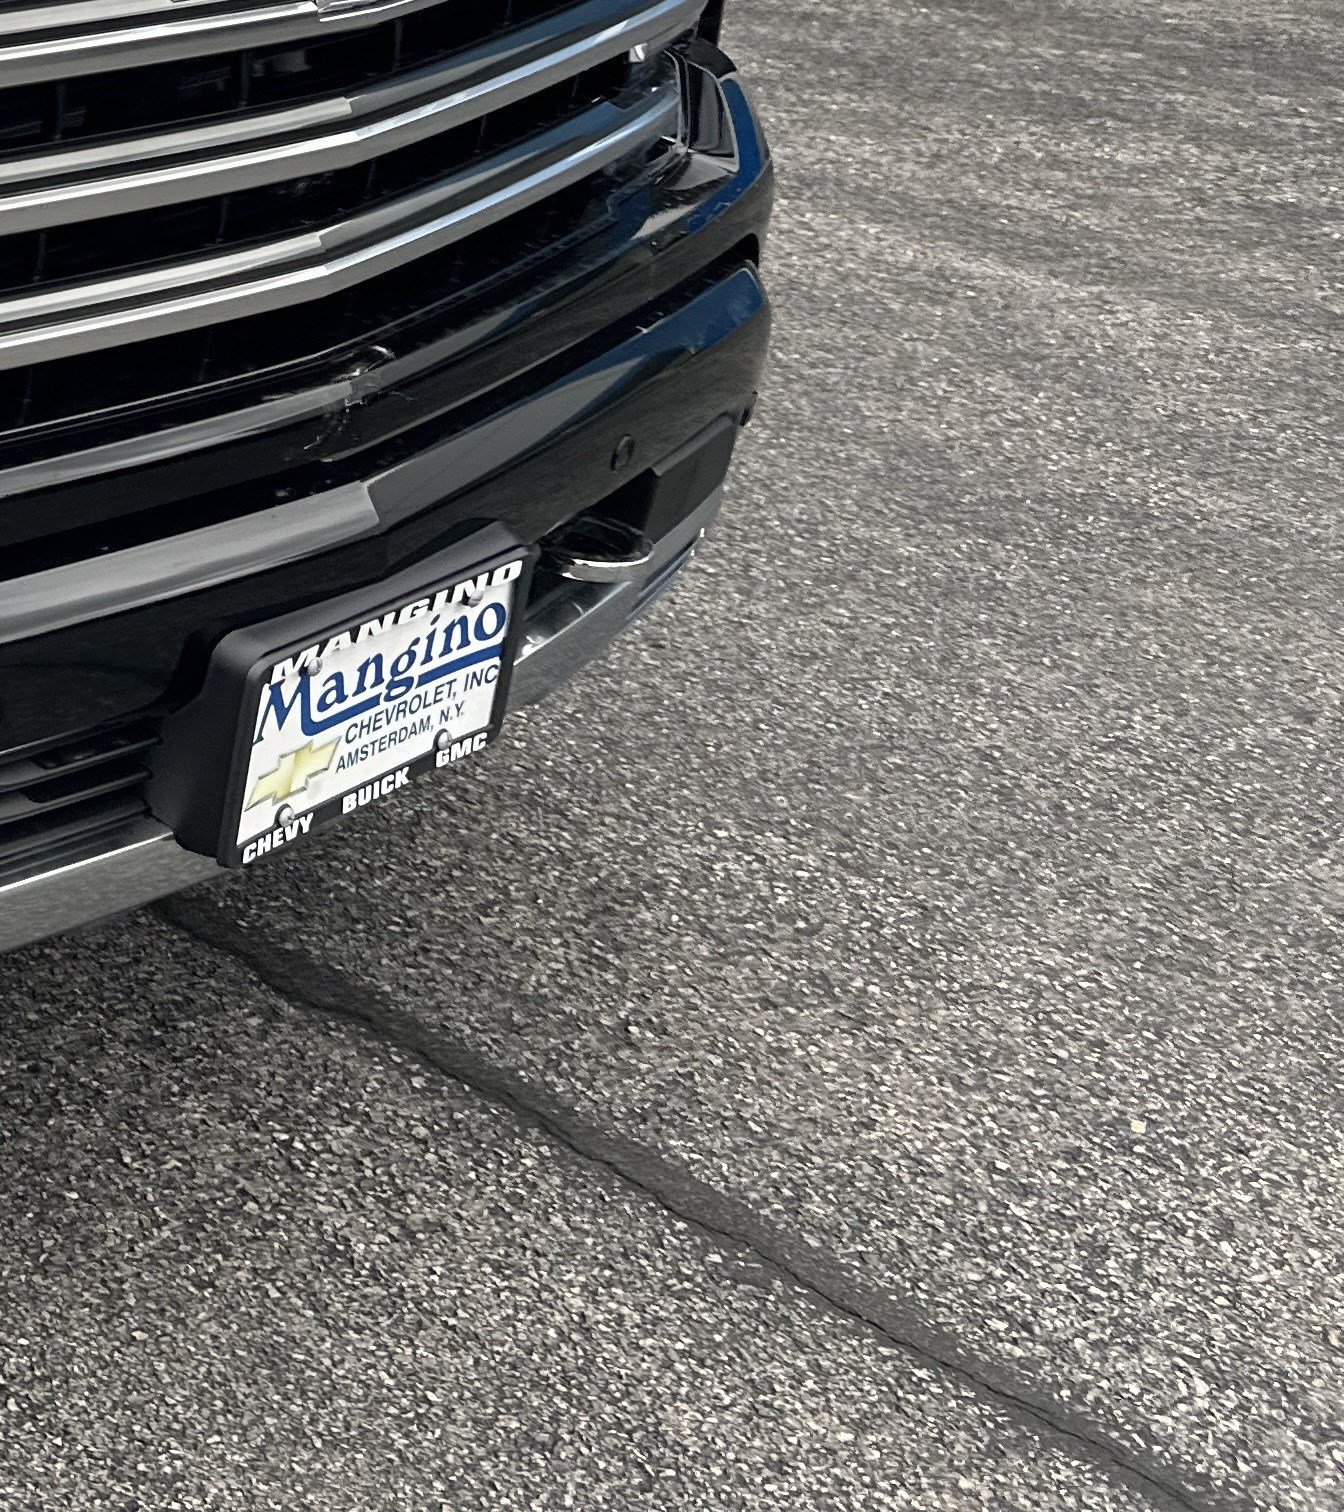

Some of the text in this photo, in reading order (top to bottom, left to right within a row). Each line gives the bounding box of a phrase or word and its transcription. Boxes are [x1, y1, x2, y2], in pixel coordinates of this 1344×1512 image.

[252, 601, 508, 745] Mangino
[271, 559, 524, 685] MANGINO
[335, 700, 465, 774] AMSTERDAM, N.Y.
[345, 678, 458, 744] CHEVROLET,
[242, 731, 489, 864] CHEVY BUICK GMC
